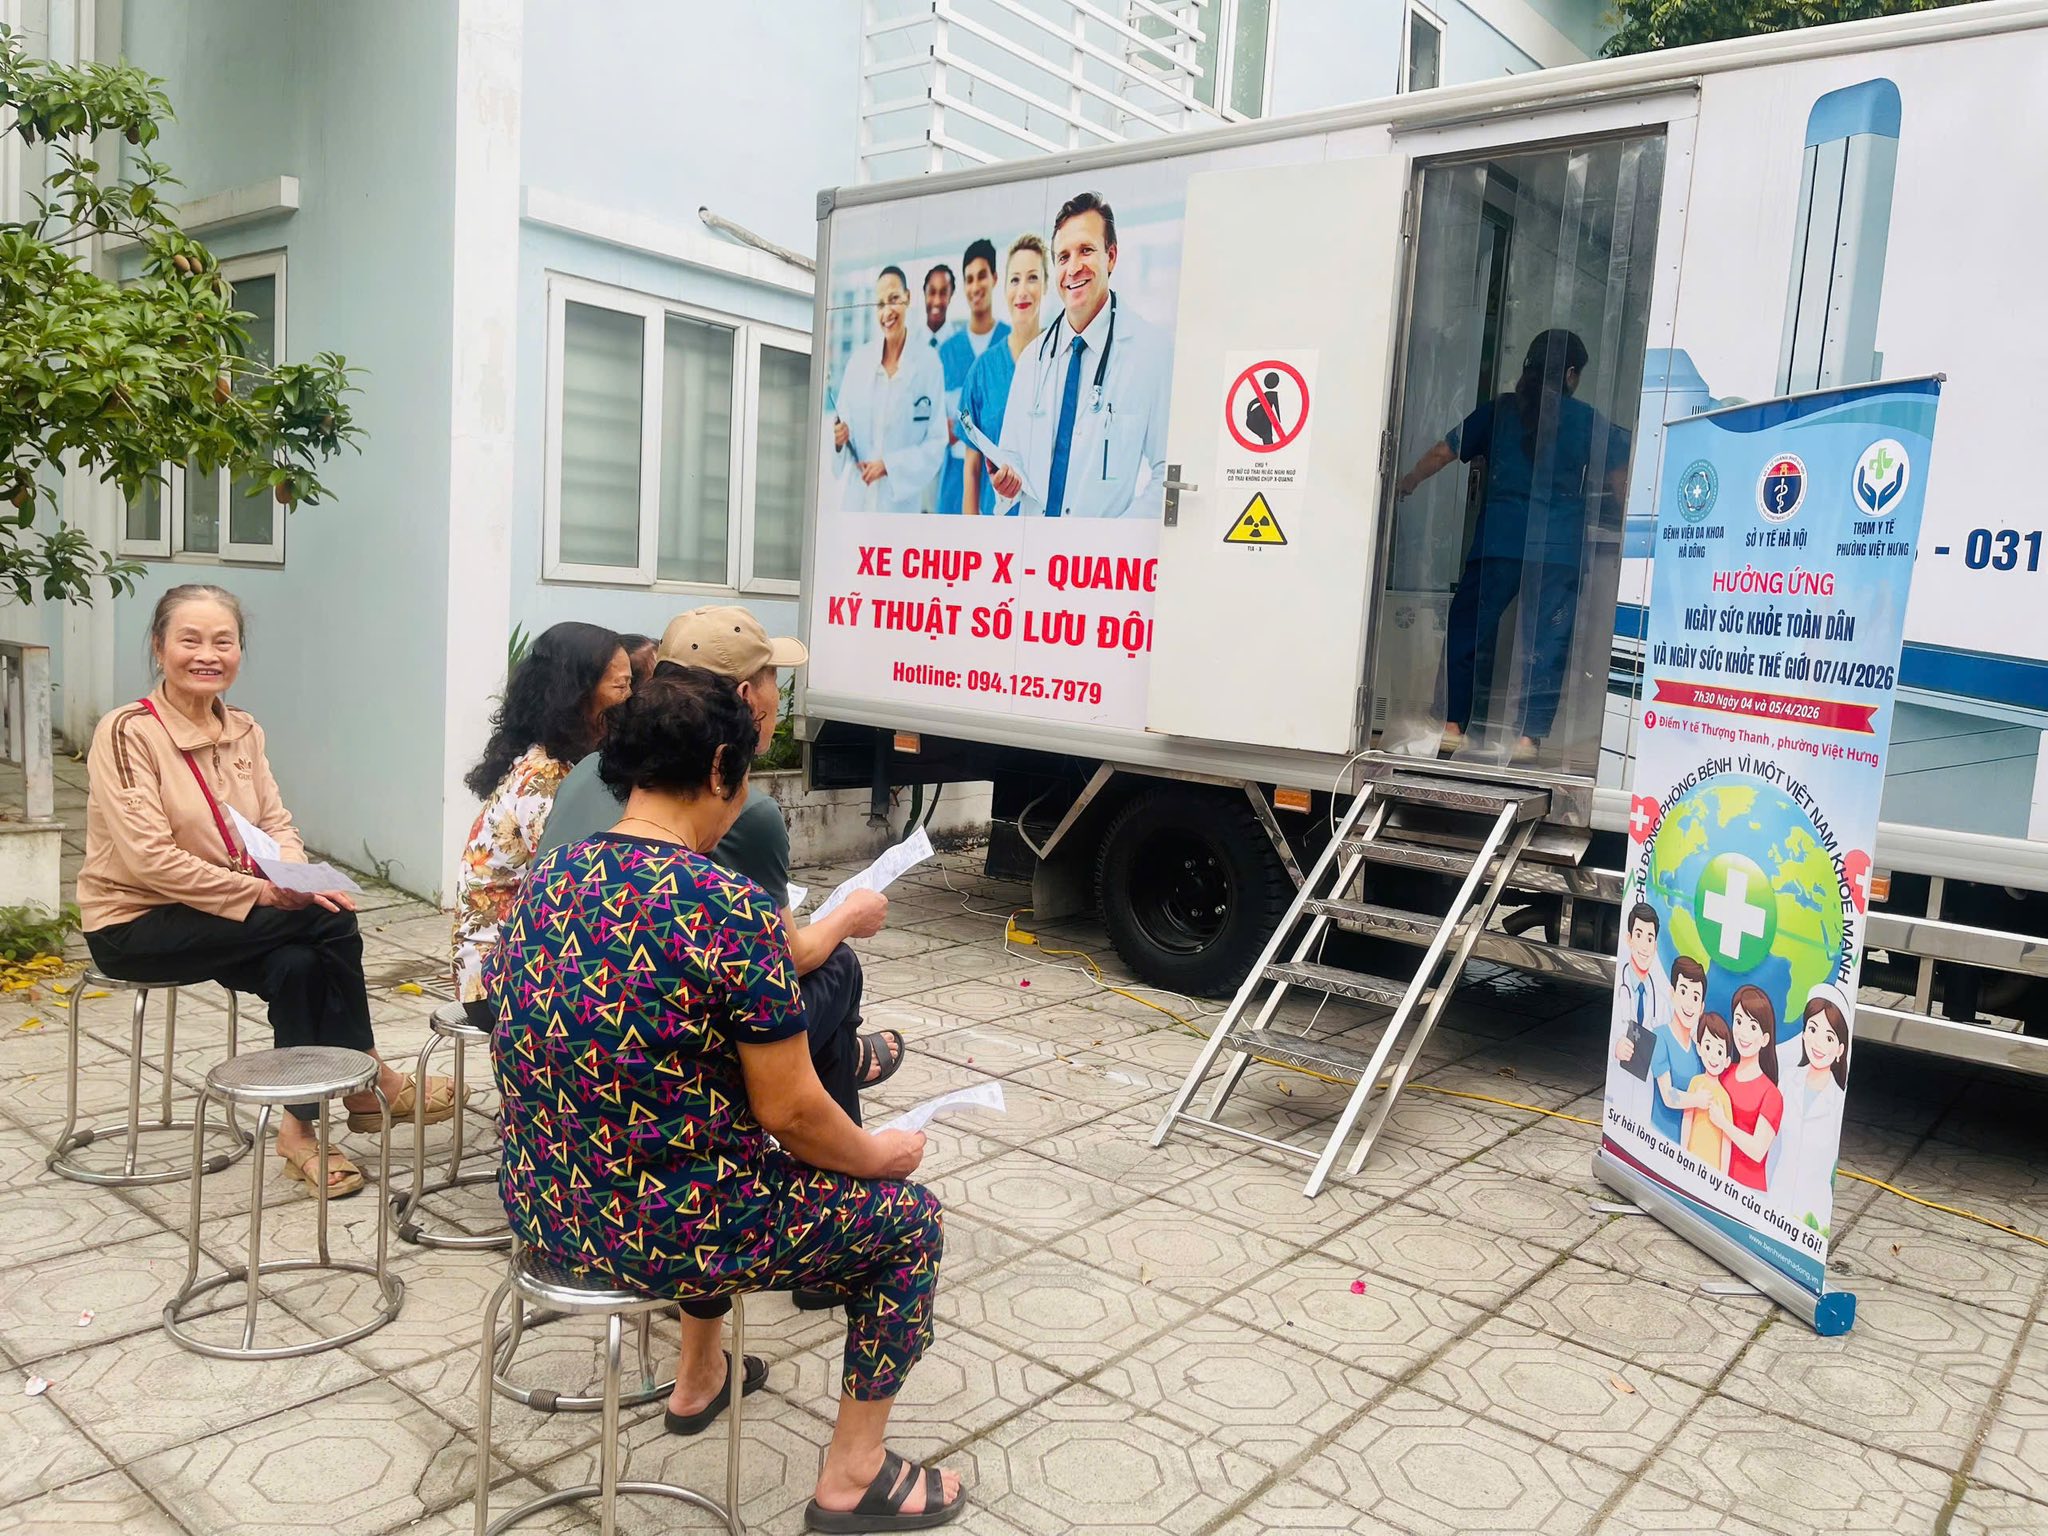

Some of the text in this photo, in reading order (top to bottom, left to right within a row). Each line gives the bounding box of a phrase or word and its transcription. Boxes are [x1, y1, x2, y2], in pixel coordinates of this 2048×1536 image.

[1663, 524, 1679, 542] BỆNH
[1681, 524, 1694, 542] VIỆN
[1706, 526, 1724, 539] KHOA
[1745, 527, 1808, 550] SỞ Y TẾ HÀ NỘI
[1853, 517, 1897, 538] TRẠM Y TẾ
[857, 546, 1158, 593] XE CHỤP X - QUANG
[1679, 543, 1687, 558] HÀ
[1836, 540, 1866, 556] PHƯỜNG
[1868, 540, 1886, 560] VIỆT
[1887, 542, 1909, 556] HƯNG
[1965, 528, 2042, 571] 031
[1712, 564, 1835, 596] HƯỞNG ỨNG
[828, 592, 1153, 659] KỸ THUẬT SỐ LƯU ĐỘ
[1684, 603, 1856, 642] NGÀY SỨC KHỎE TOÀN DÂN
[893, 661, 1102, 705] Hotline: 094.125.7979
[1653, 640, 1894, 690] VÀ NGÀY SỨC KHỎE THẾ GIỚI 07/4/2026
[1693, 690, 1820, 719] 7h30 Ngày 04 và 05/4/2026
[1682, 720, 1689, 731] Y
[1690, 721, 1700, 733] tế
[1701, 723, 1736, 743] Thượng
[1738, 729, 1770, 746] Thanh
[1777, 736, 1819, 757] phường
[1821, 743, 1844, 760] Việt
[1846, 747, 1879, 768] Hưng
[1635, 753, 1855, 984] CHỦ ĐỘNG PHÒNG BỆNH VÌ MỘT VIỆT NAM KHỎE MẠNH
[1608, 1108, 1823, 1254] Sự hài lòng của bạn là uy tín của chúng tôi!
